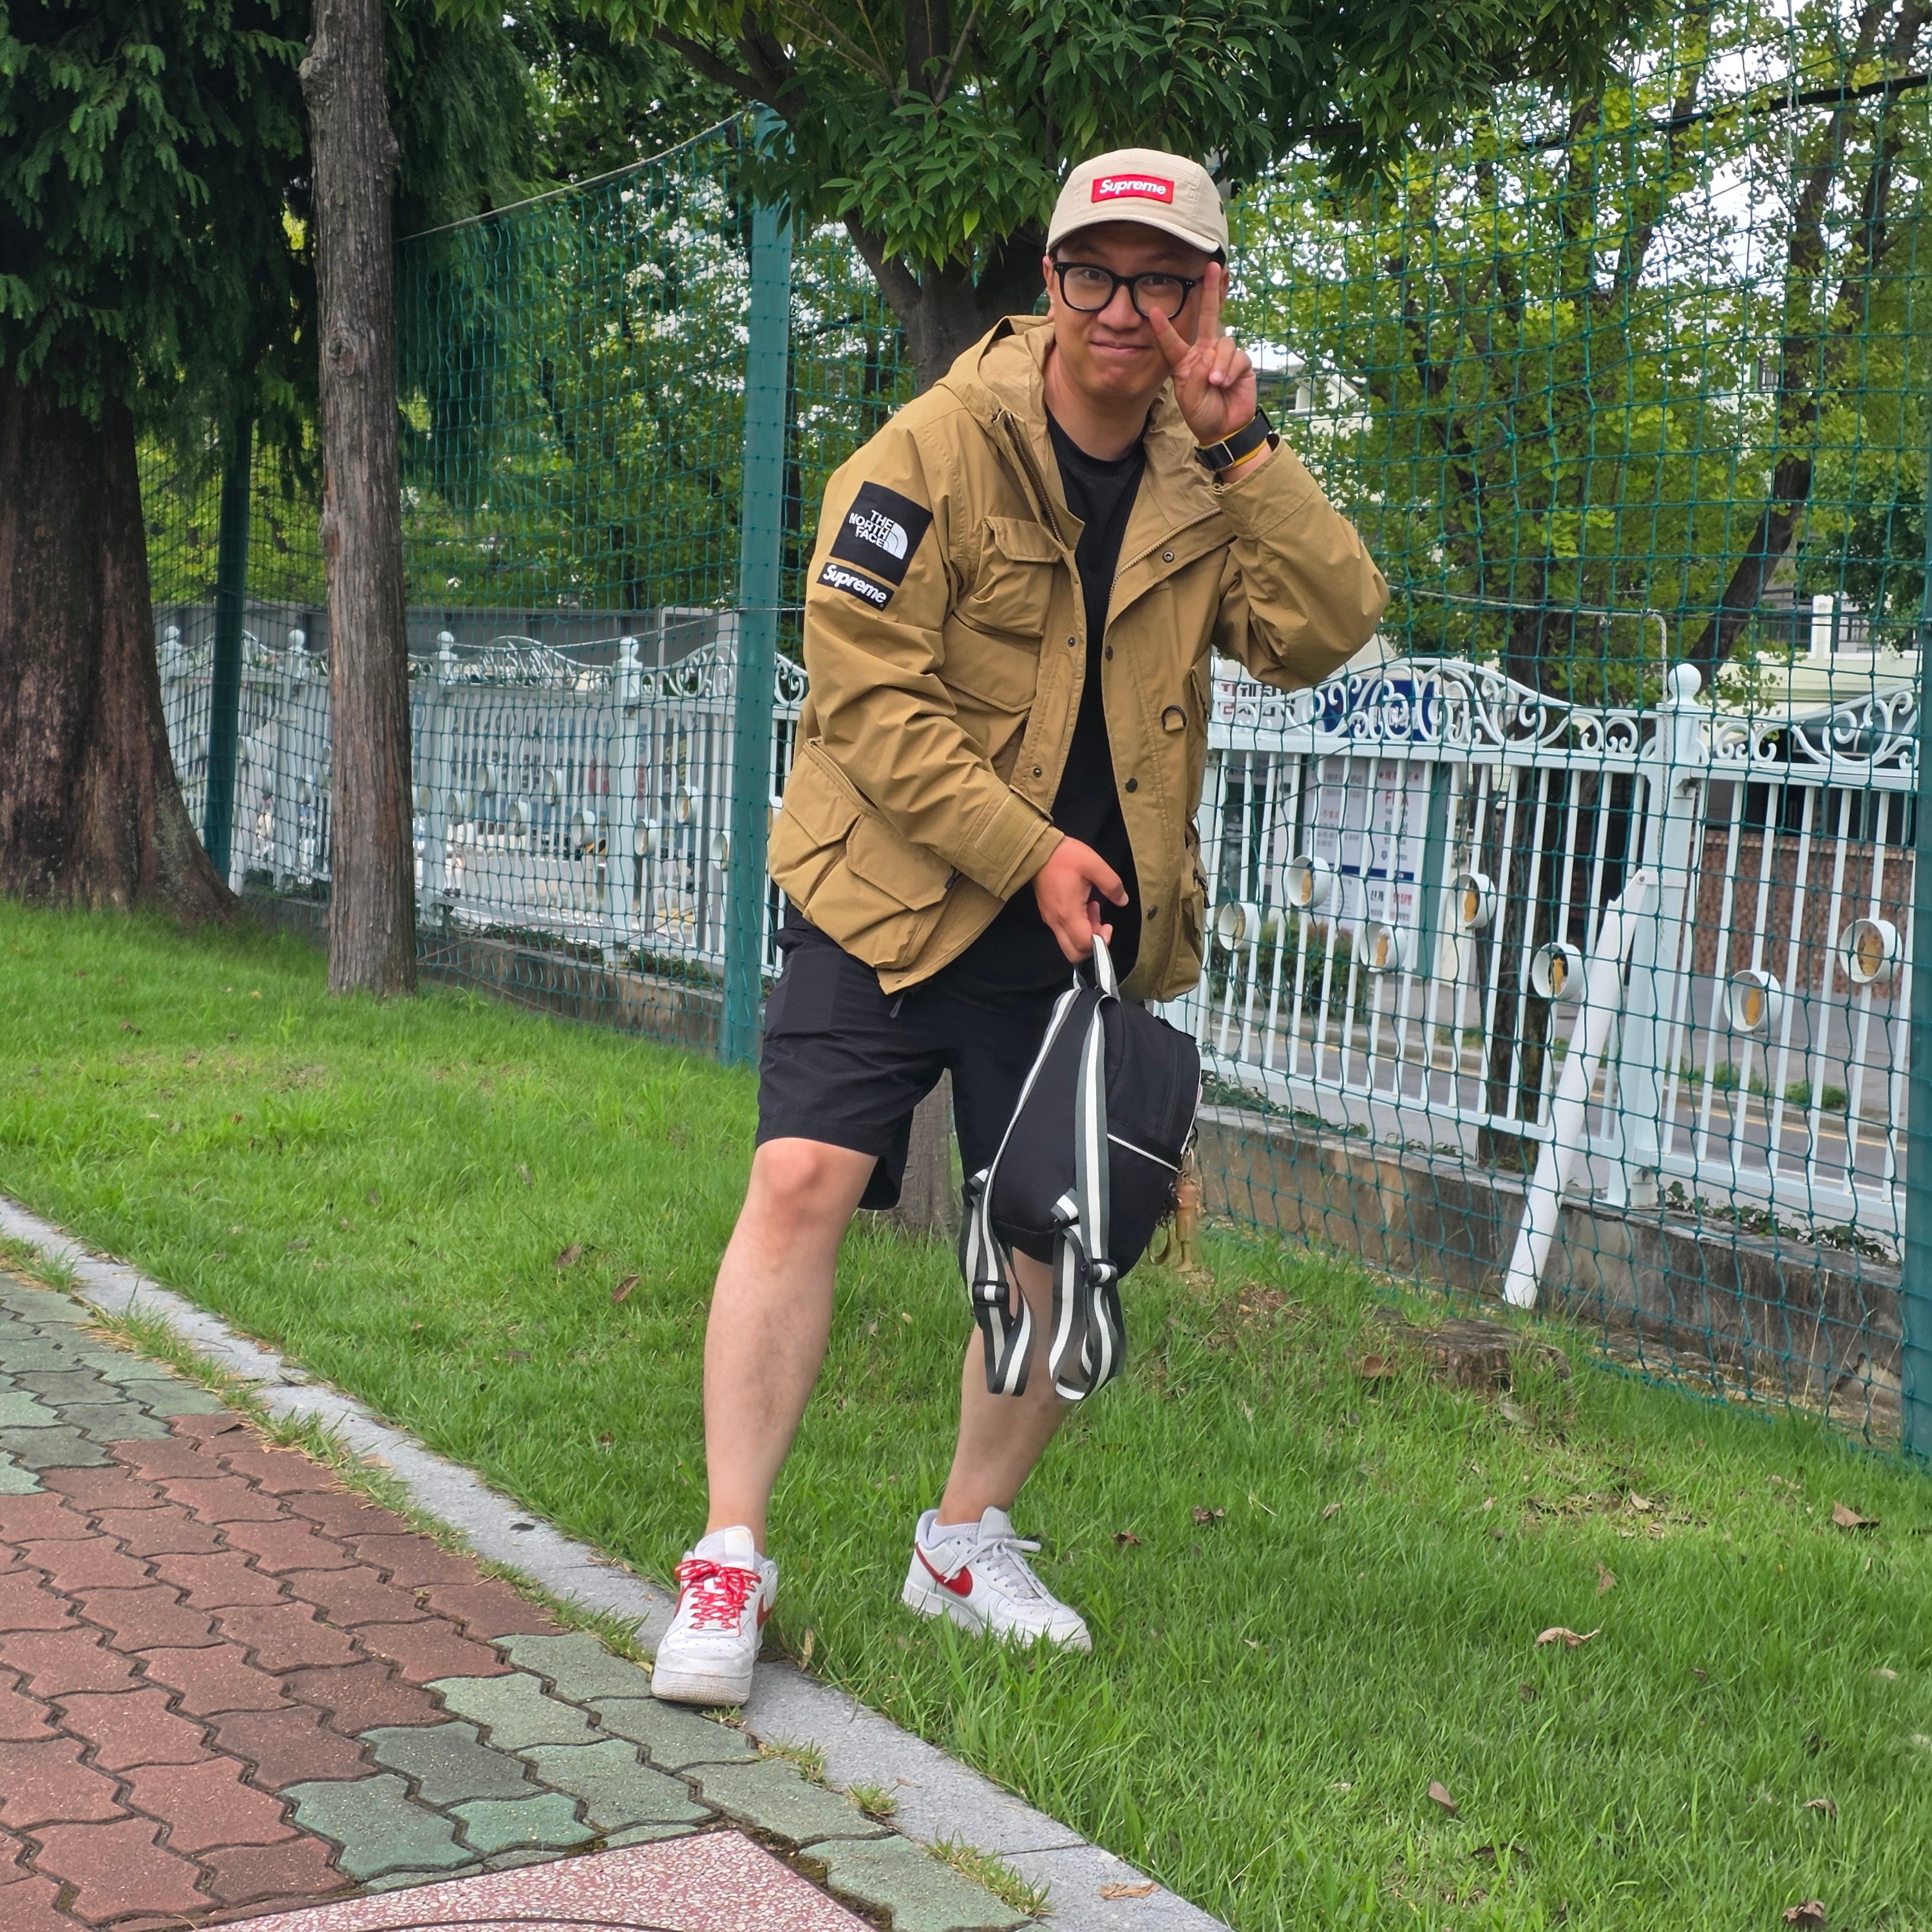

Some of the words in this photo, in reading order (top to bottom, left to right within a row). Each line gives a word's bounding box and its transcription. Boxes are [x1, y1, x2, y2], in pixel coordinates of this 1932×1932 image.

[1099, 178, 1167, 195] Supreme
[849, 512, 890, 540] NORTH
[871, 509, 895, 530] THE
[855, 526, 886, 548] FACE
[822, 564, 887, 603] Supreme
